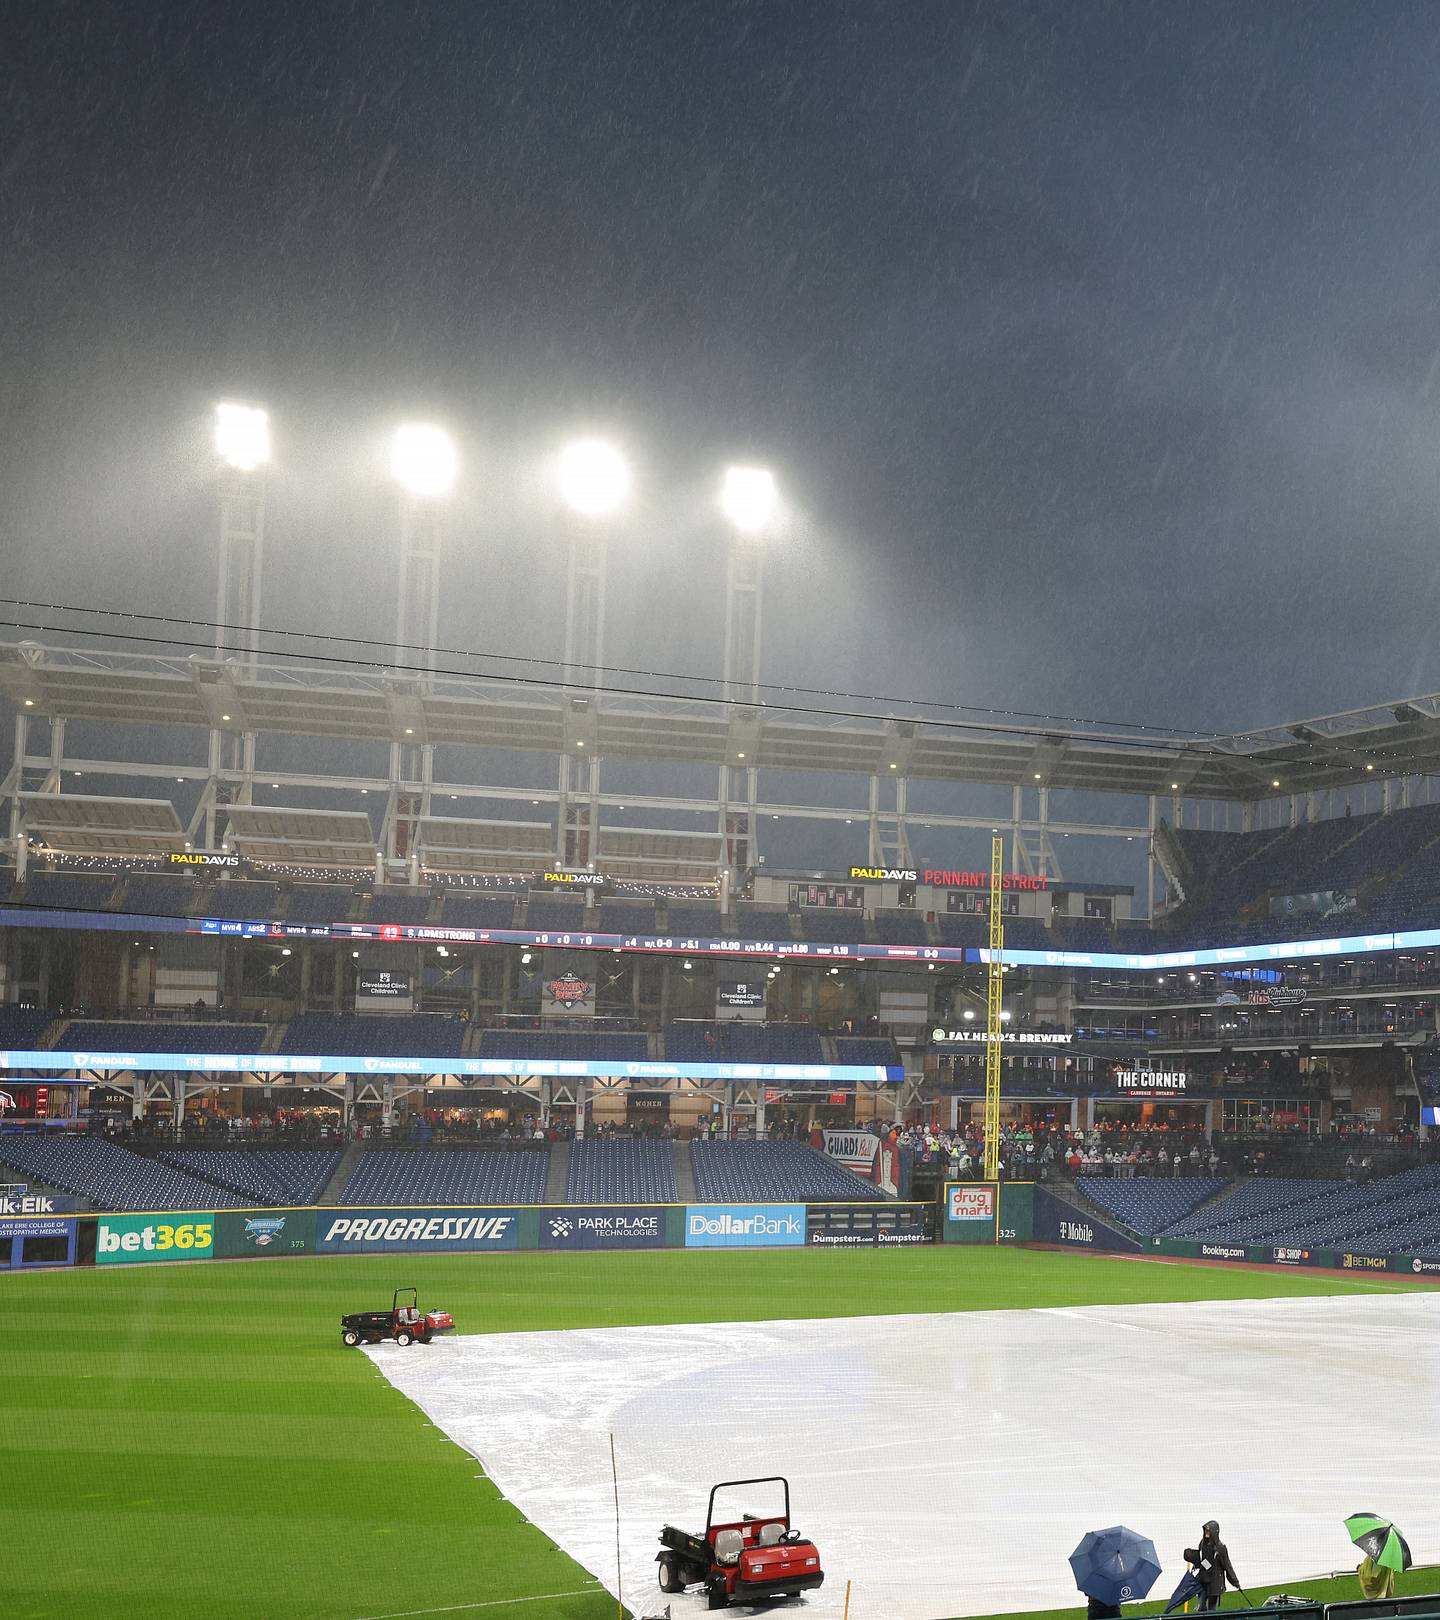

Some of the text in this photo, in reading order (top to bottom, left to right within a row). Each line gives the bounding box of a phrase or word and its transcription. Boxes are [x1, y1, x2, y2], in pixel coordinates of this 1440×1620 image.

[924, 870, 987, 888] PENNANT
[417, 929, 476, 940] ARMSTRONG
[949, 1032, 970, 1041] FAT
[1019, 1034, 1072, 1043] BREWERY
[1116, 1071, 1187, 1089] THE CORNER
[828, 1136, 858, 1156] GUARDS
[953, 1187, 986, 1207] drug
[324, 1217, 513, 1241] PROGRESSIVE
[578, 1217, 658, 1229] PARK PLACE
[98, 1223, 213, 1253] bet365
[595, 1229, 658, 1237] TECHNOLOGIES
[812, 1233, 873, 1243] Dumpsters.com
[999, 1229, 1016, 1238] 325
[1202, 1245, 1245, 1258] Booking.com
[1286, 1248, 1302, 1260] SHOP
